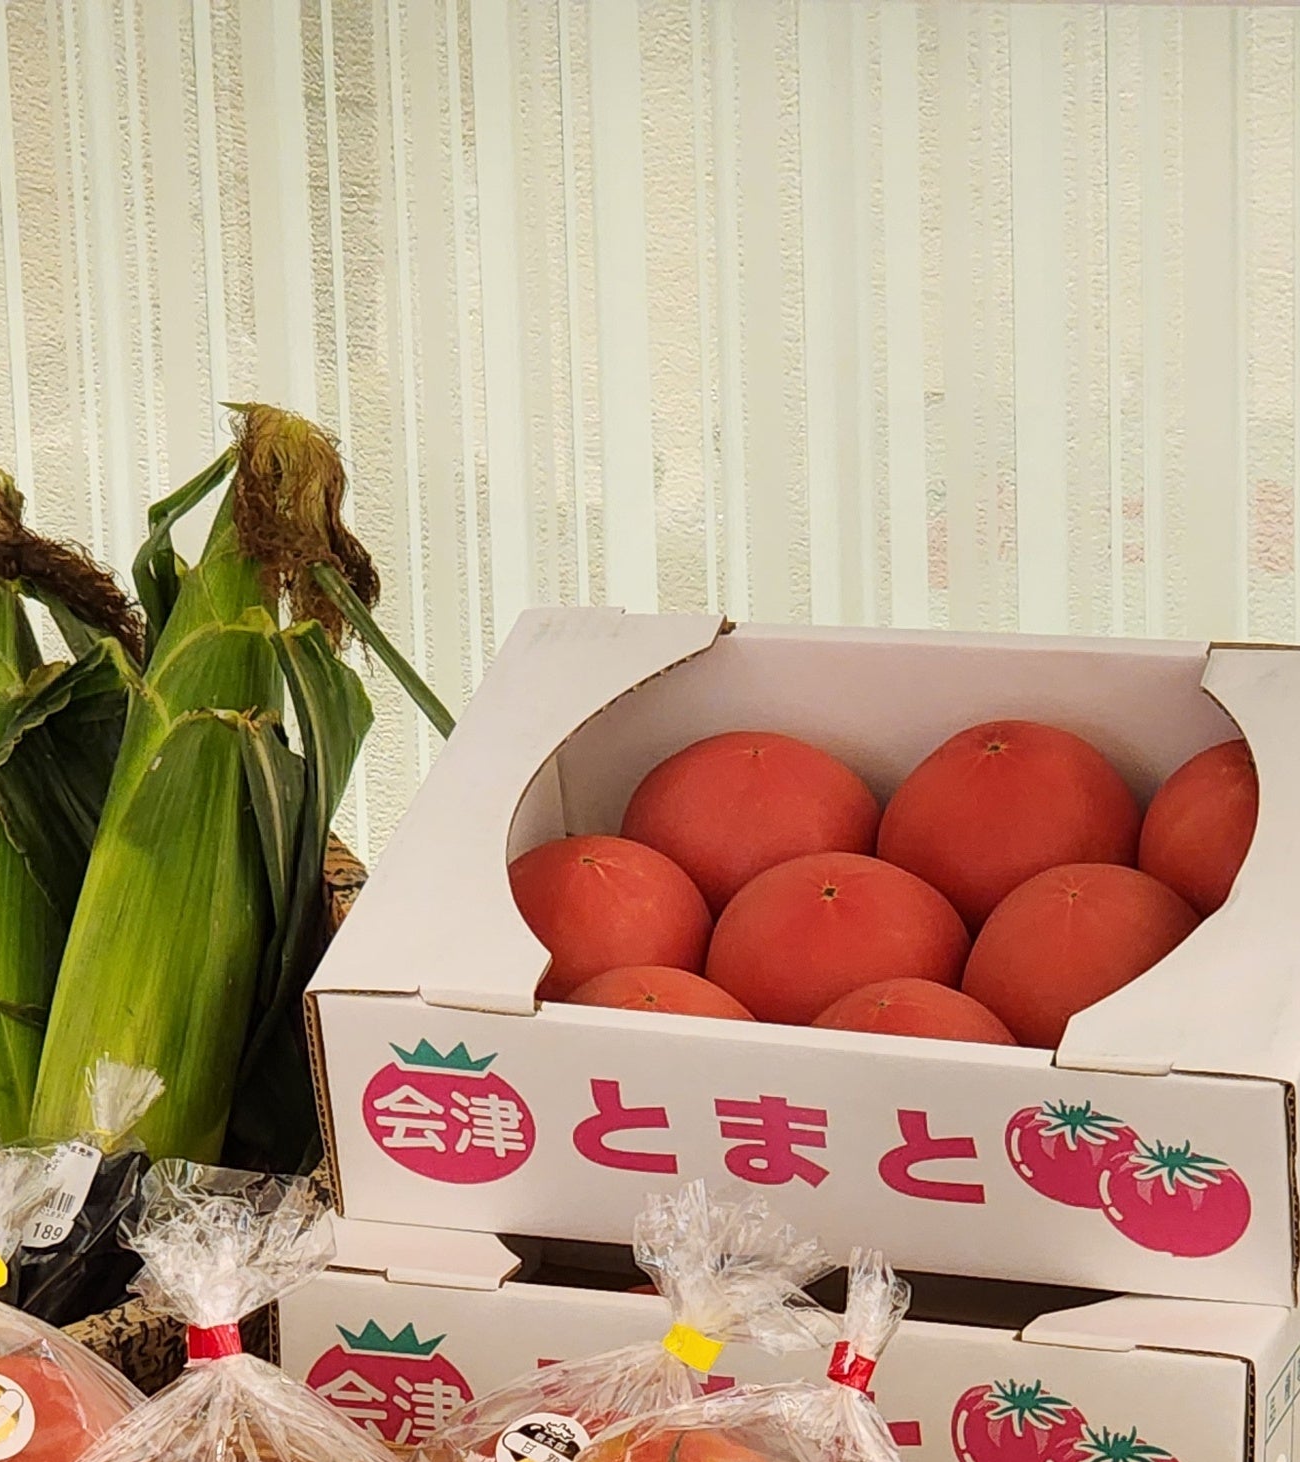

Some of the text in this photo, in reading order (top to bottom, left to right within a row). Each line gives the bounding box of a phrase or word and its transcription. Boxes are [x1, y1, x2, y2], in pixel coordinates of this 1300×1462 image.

[374, 1077, 987, 1205] 会津 とまと
[33, 1221, 63, 1241] 189
